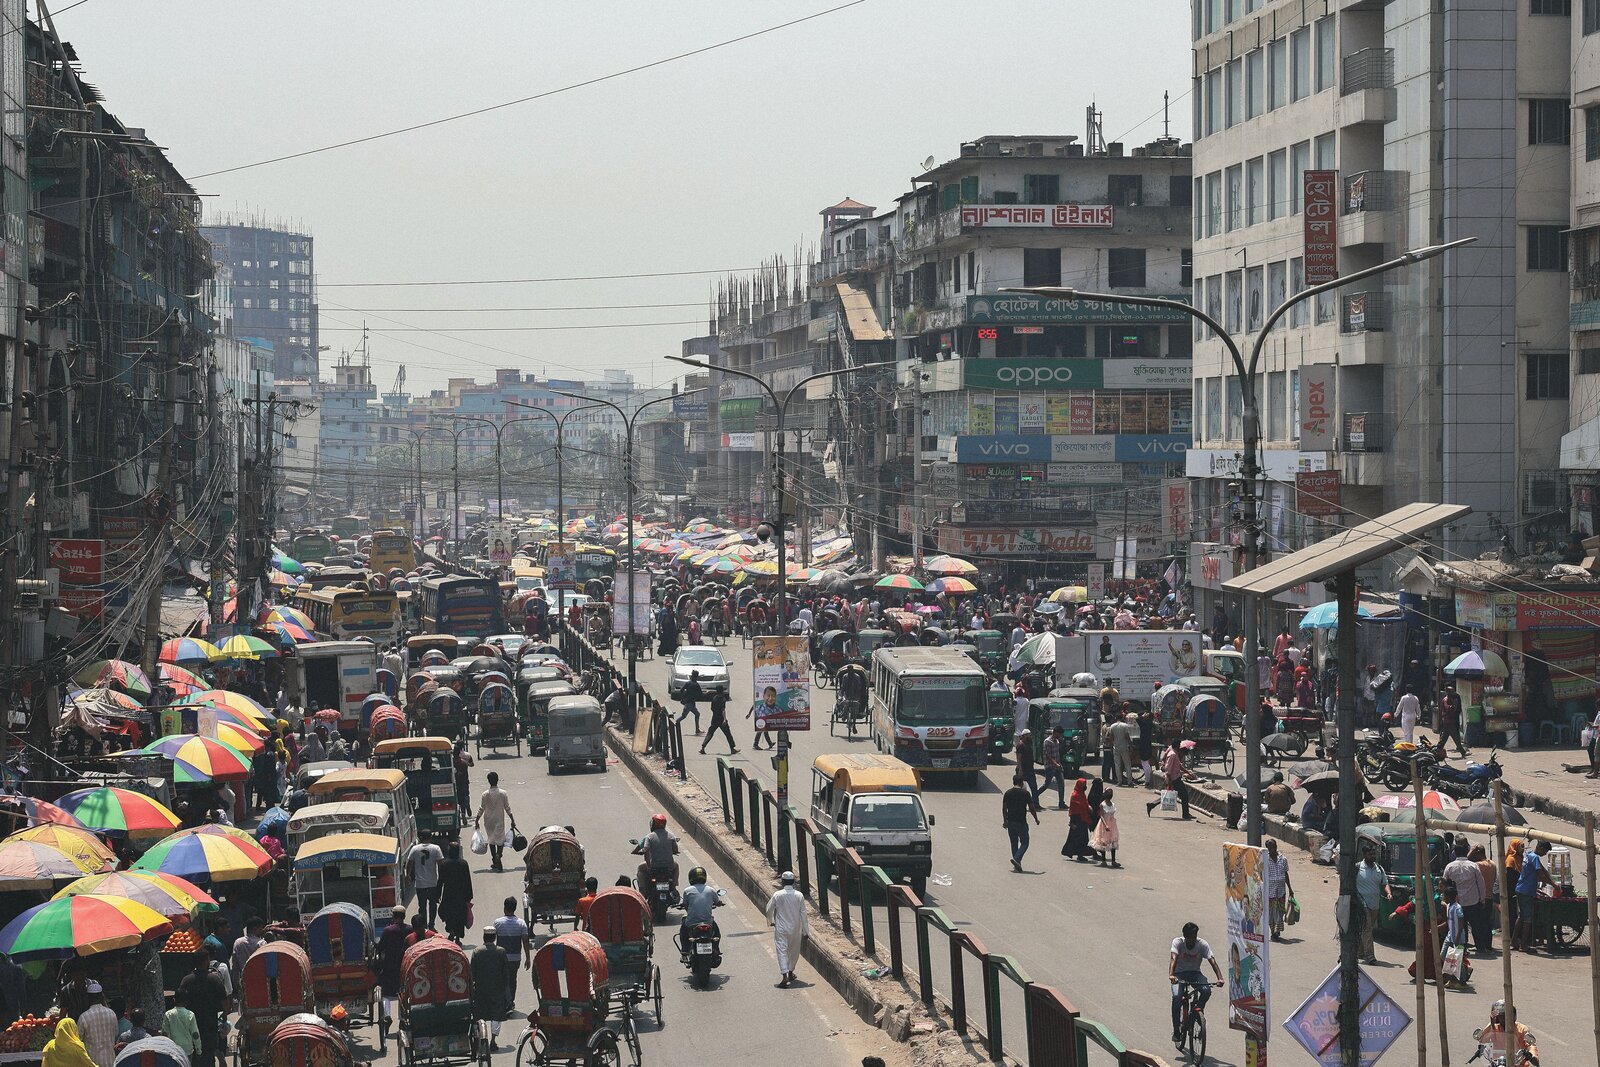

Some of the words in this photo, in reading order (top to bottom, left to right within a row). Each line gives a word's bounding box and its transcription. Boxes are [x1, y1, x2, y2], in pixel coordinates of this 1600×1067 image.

[963, 207, 1046, 227] ন্যাশনাল
[1052, 205, 1113, 228] টেইলার্স
[993, 296, 1040, 313] হোটেল
[997, 367, 1073, 386] oppo
[1303, 379, 1330, 434] Apex
[979, 441, 1030, 455] vivo
[1137, 439, 1188, 454] vivo
[1040, 528, 1094, 551] Dada
[49, 541, 92, 559] Kazi's
